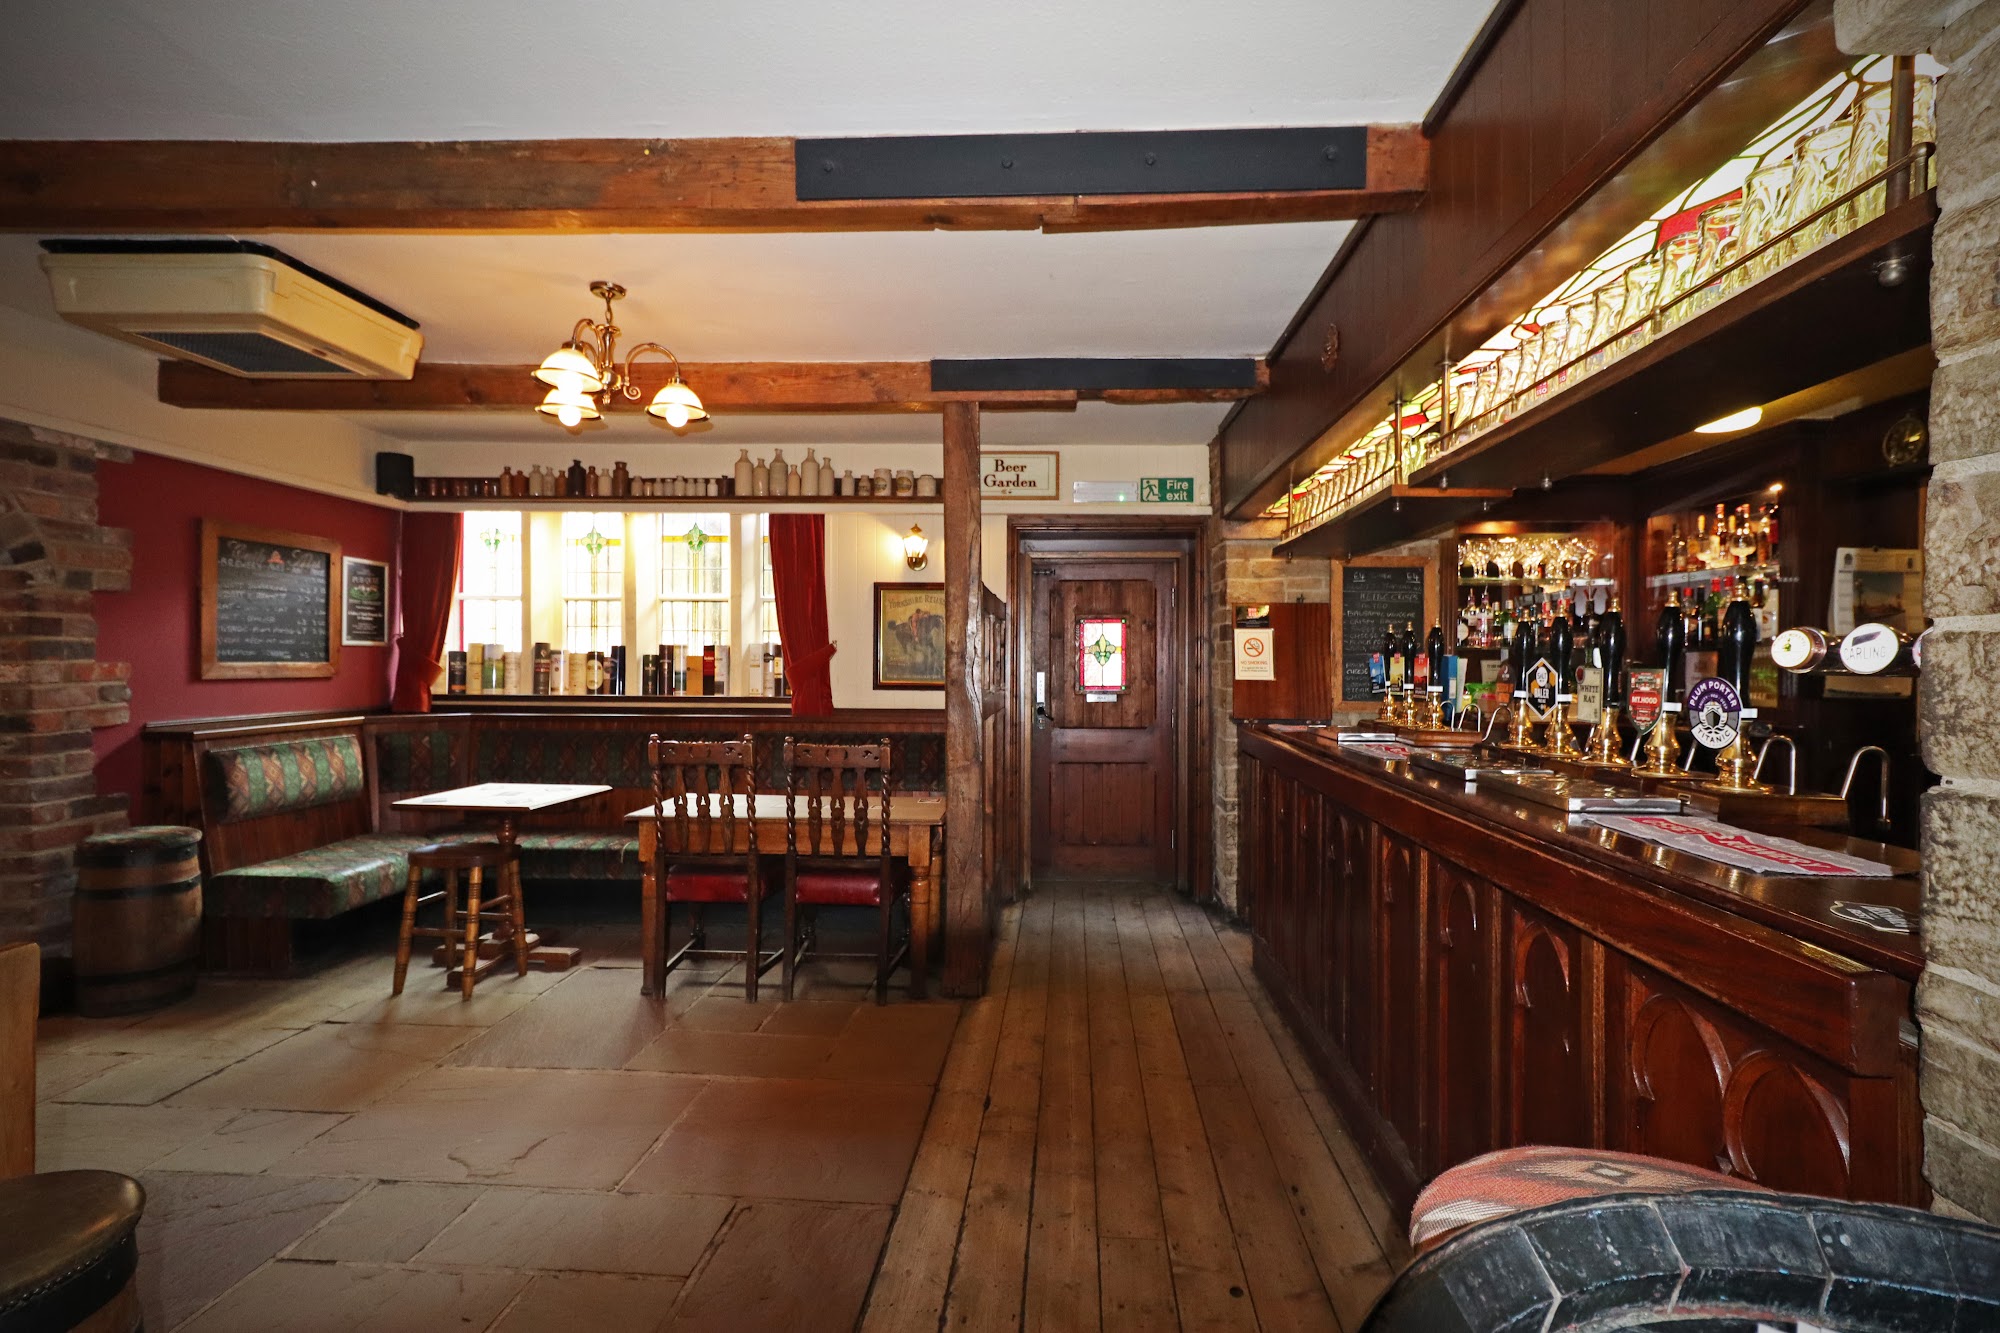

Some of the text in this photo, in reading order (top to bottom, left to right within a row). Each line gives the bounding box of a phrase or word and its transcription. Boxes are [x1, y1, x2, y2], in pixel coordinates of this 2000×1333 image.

[994, 459, 1027, 472] Beer
[984, 474, 1037, 487] Garden
[1166, 480, 1189, 490] Fire
[1166, 491, 1188, 501] exit
[1845, 646, 1887, 661] CARLING
[1579, 685, 1599, 693] WHITE
[1689, 681, 1738, 707] PLUM PORTER
[1583, 695, 1596, 703] RAT
[1697, 728, 1731, 743] TITANIC
